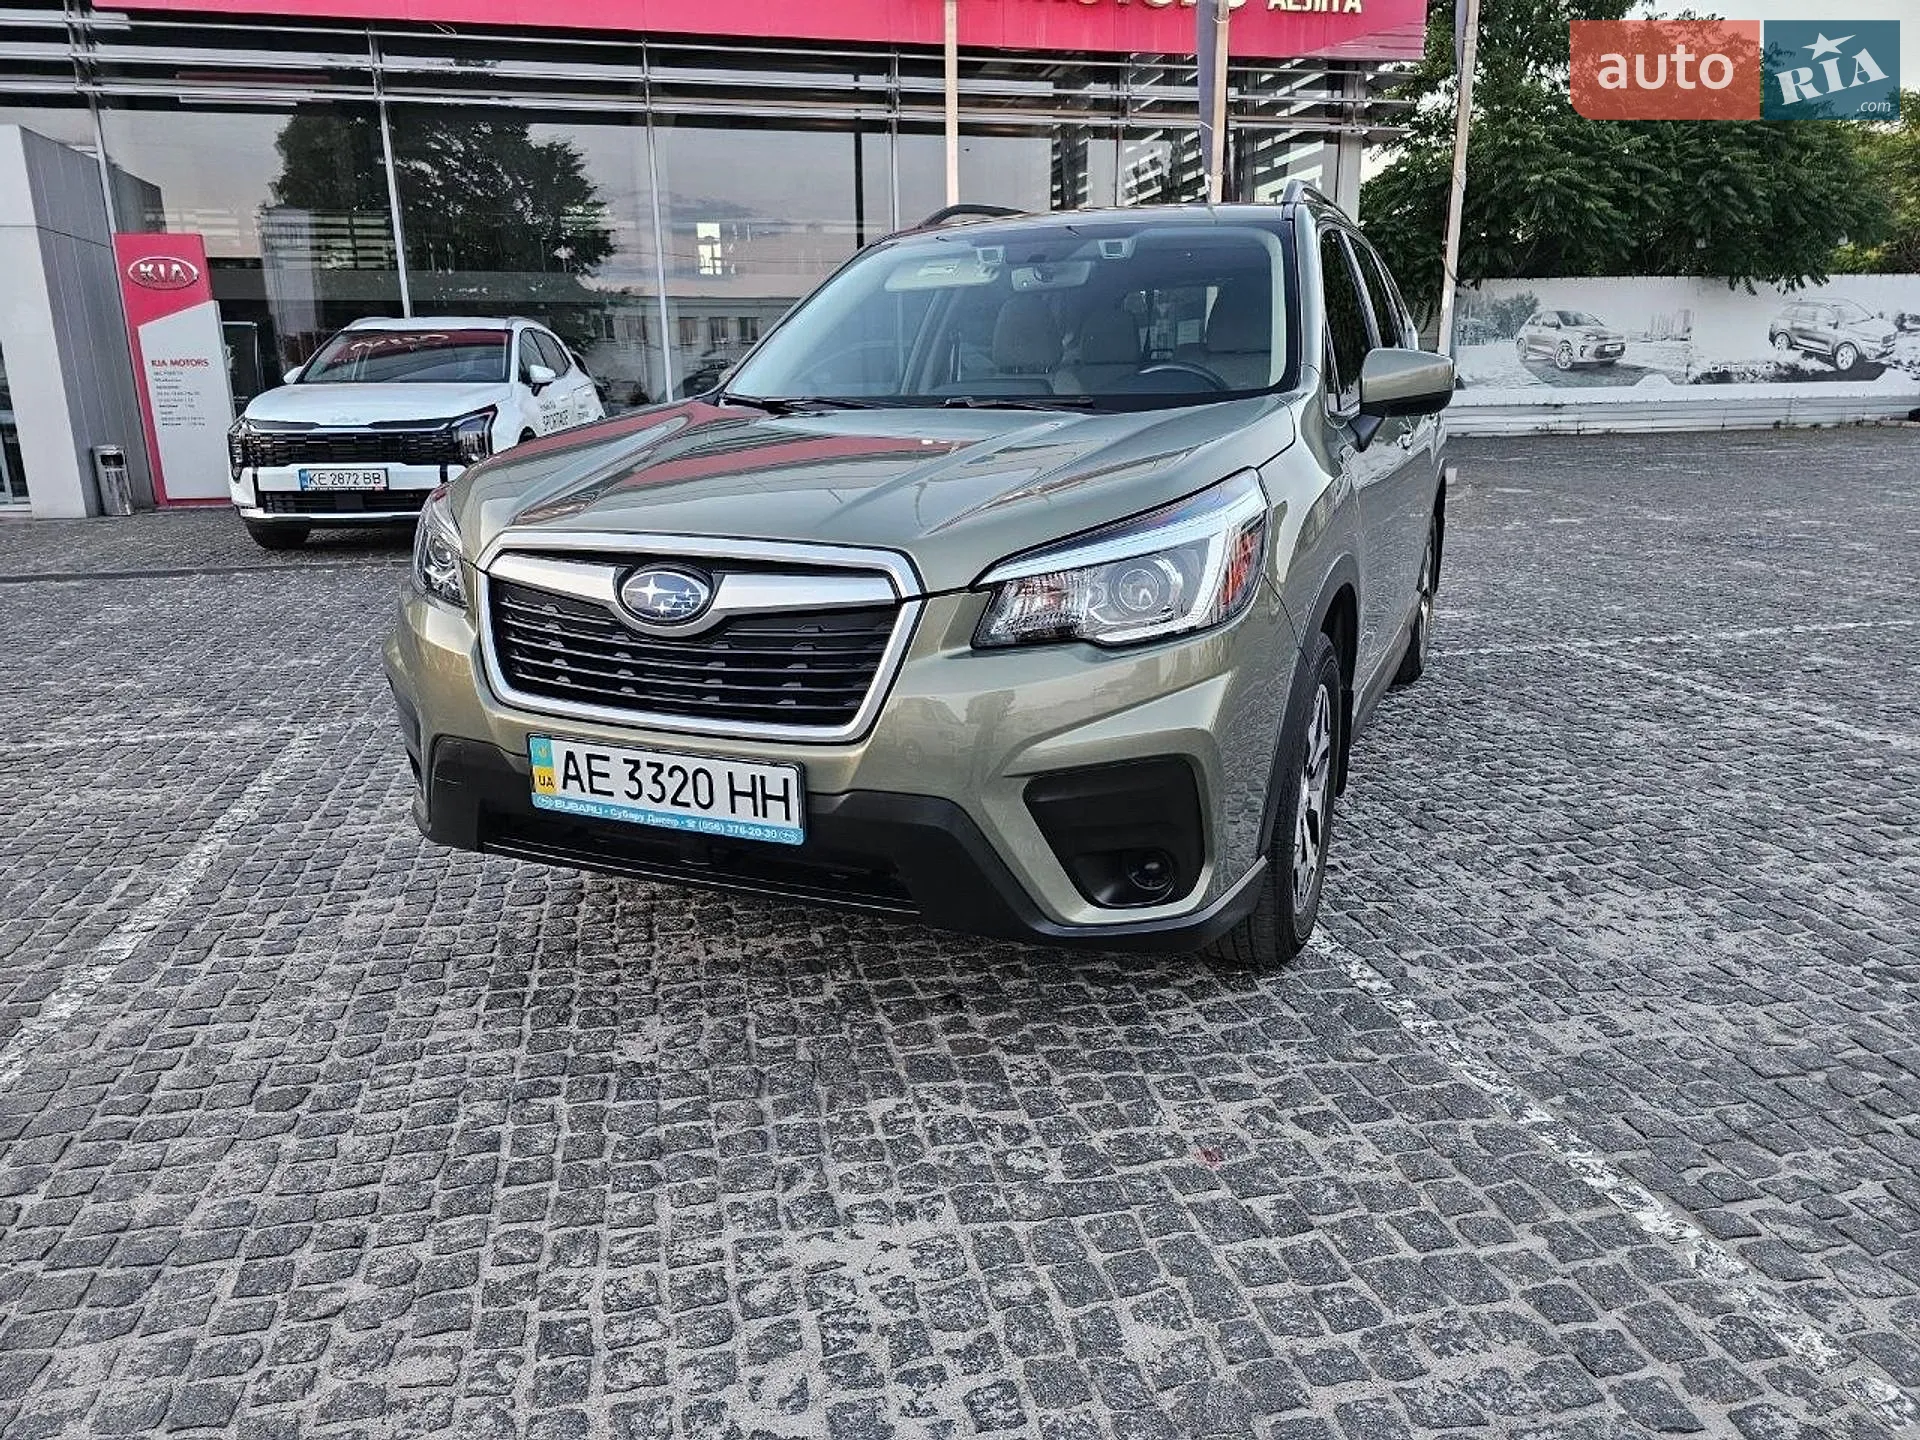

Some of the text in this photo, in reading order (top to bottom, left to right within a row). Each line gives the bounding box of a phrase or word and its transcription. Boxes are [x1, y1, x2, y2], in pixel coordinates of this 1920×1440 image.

[139, 263, 188, 282] KIA
[151, 358, 209, 368] KIA MOTORS
[309, 472, 381, 486] KE 2872 BB
[537, 773, 555, 790] UA
[561, 750, 792, 821] AE 3320 HH
